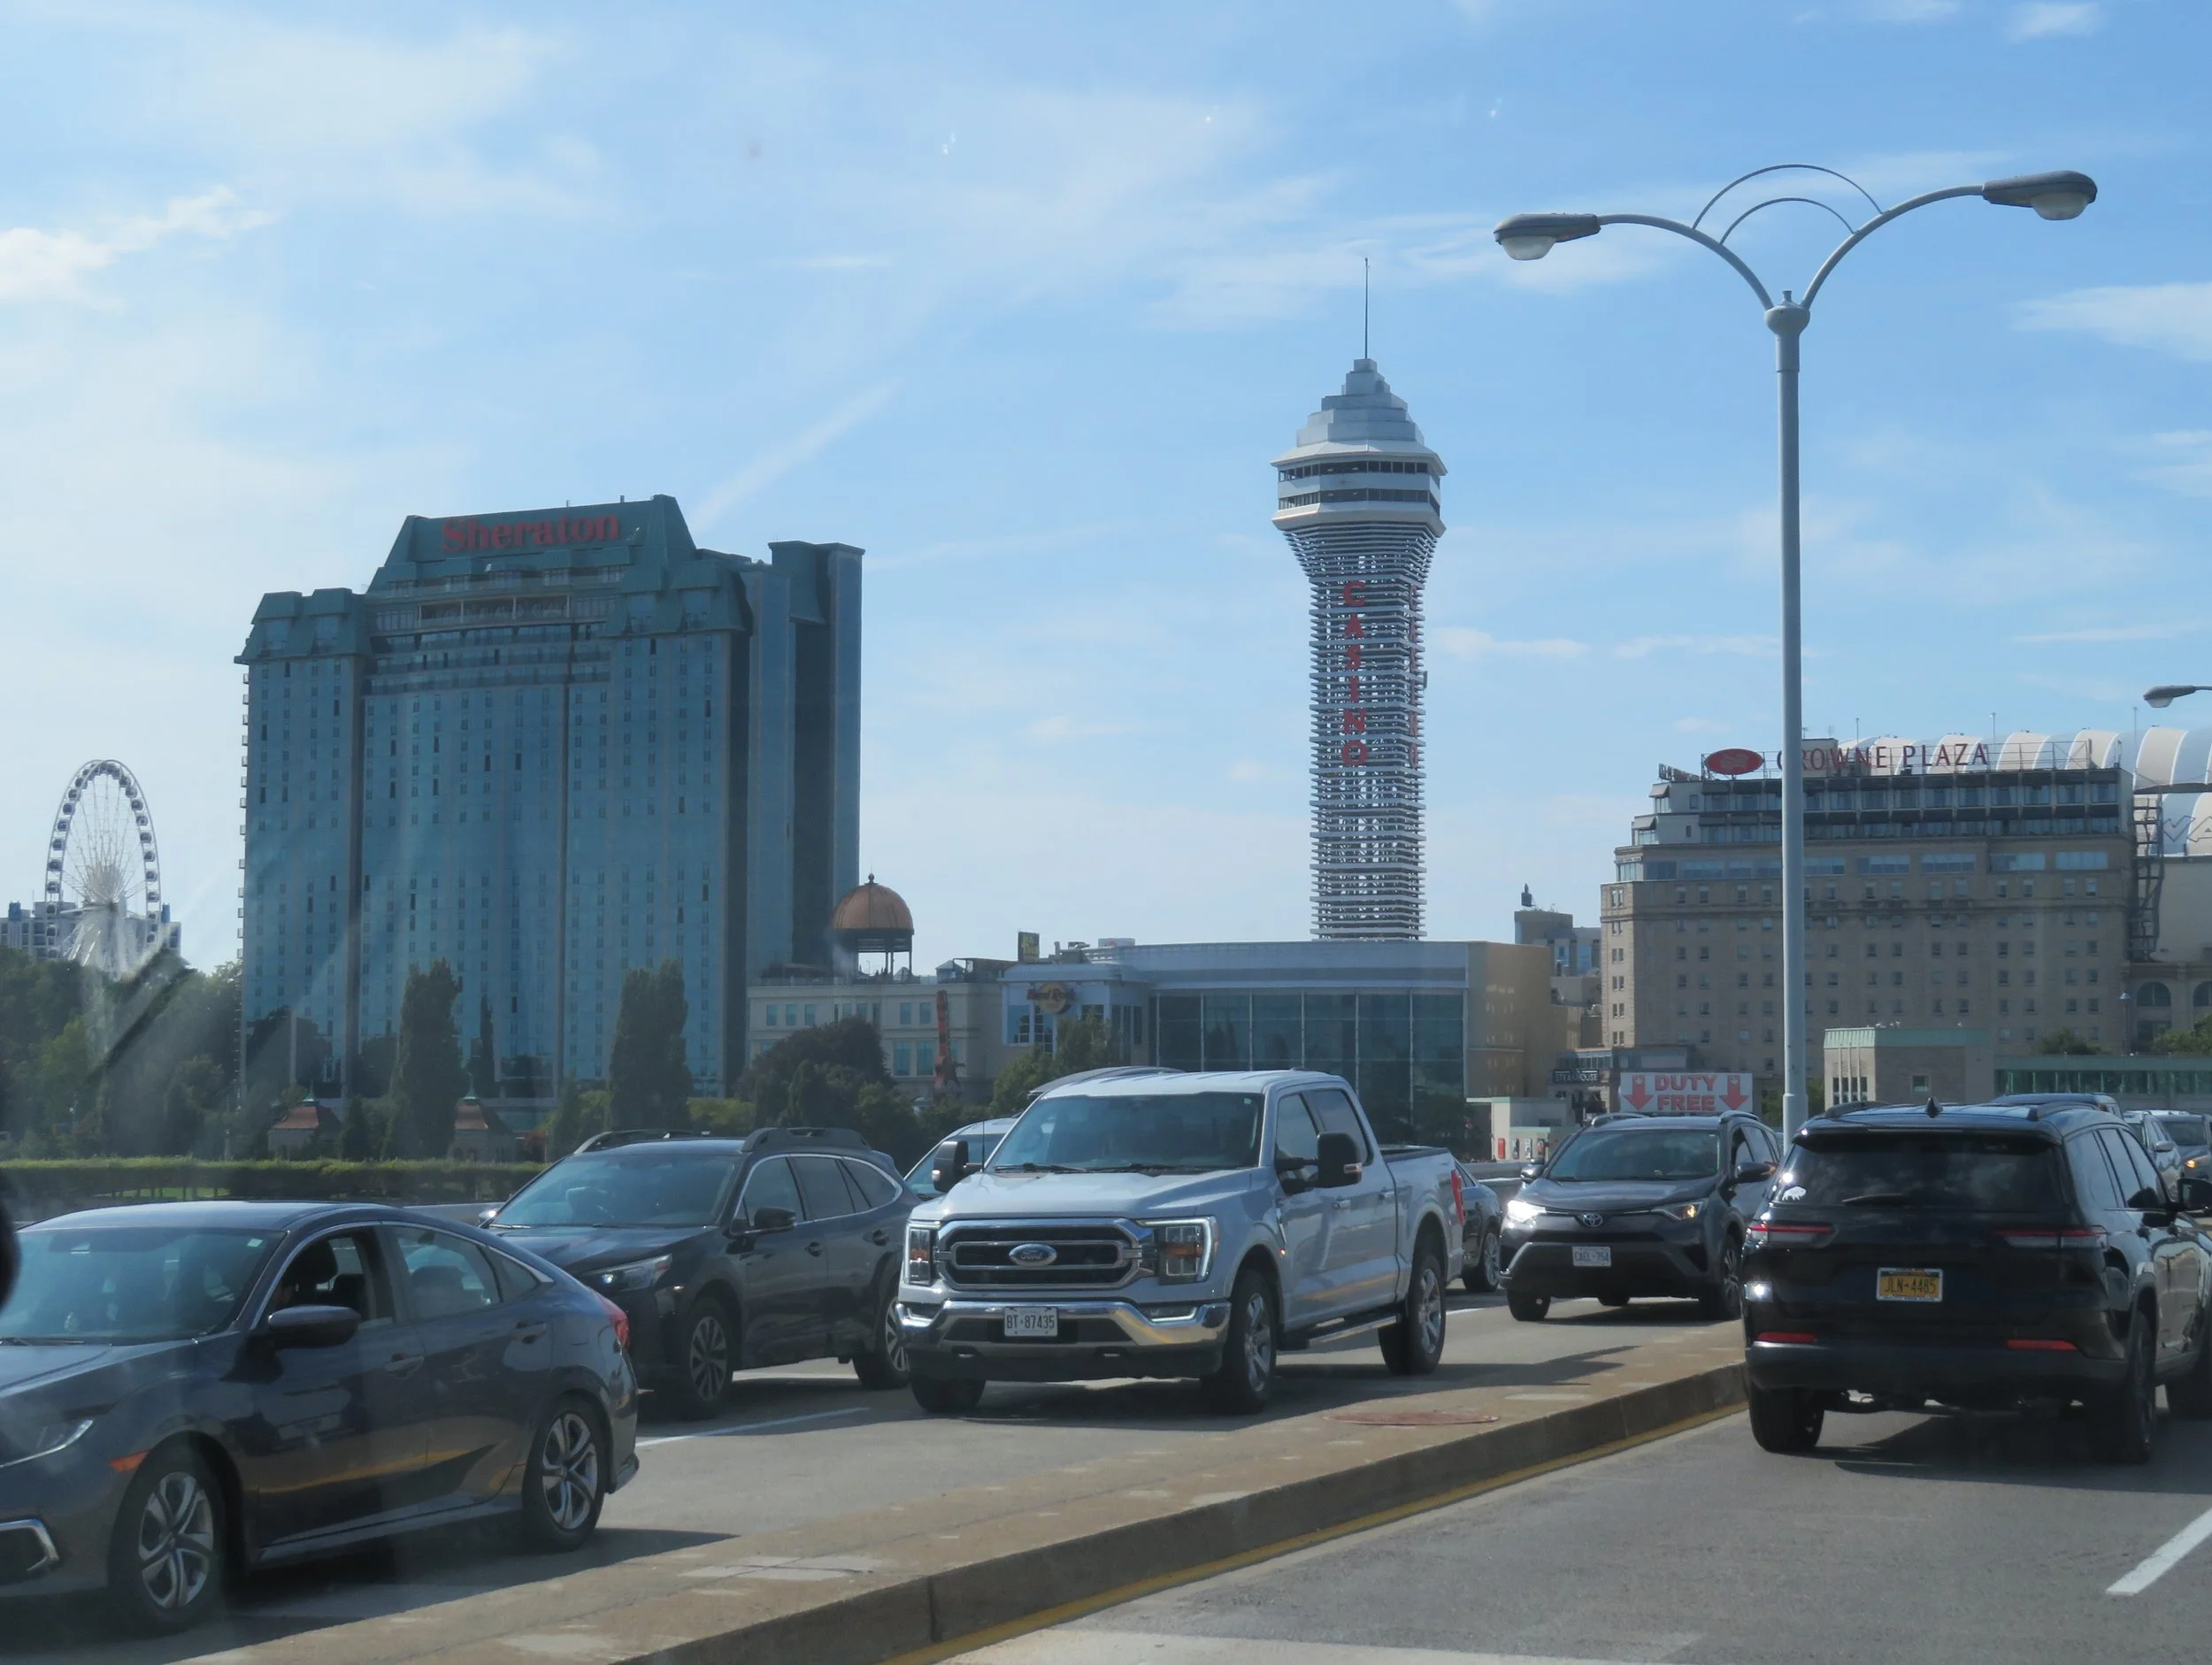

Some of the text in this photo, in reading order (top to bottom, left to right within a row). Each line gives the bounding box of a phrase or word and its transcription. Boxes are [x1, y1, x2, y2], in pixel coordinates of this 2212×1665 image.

[442, 514, 619, 553] Sheraton
[1341, 579, 1368, 766] CASINO
[1903, 742, 1989, 768] PLAZA
[1655, 1074, 1717, 1091] DUTY
[1657, 1094, 1716, 1111] FREE
